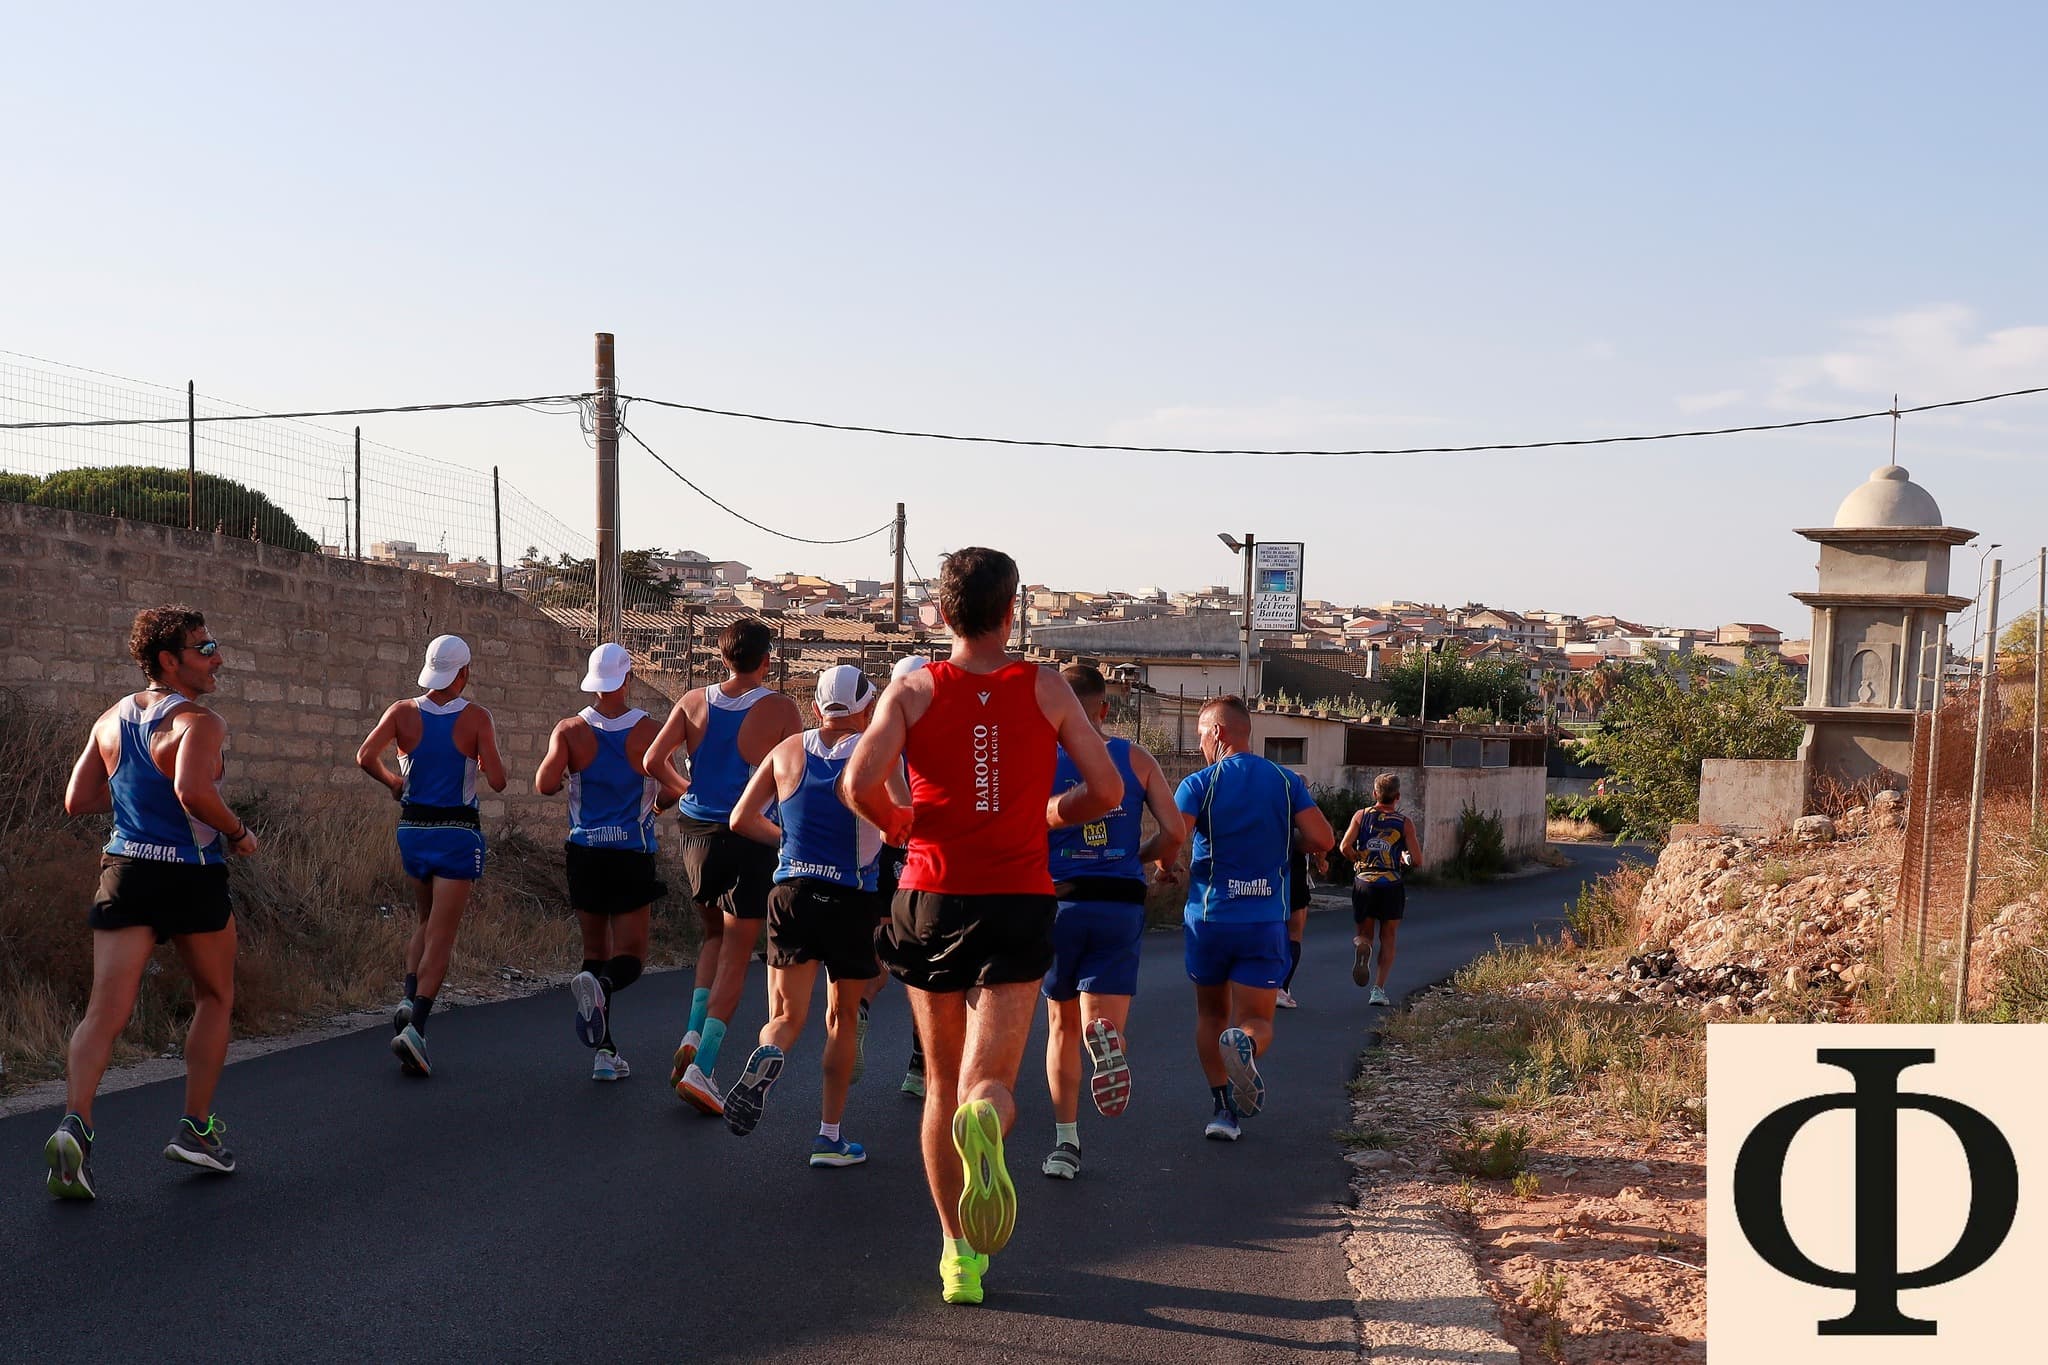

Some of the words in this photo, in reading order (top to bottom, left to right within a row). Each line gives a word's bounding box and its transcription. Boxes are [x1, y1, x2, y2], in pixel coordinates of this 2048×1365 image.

[1256, 601, 1271, 610] del
[1273, 601, 1296, 610] Ferro
[1263, 594, 1290, 602] L'Arte
[1259, 609, 1293, 618] Battuto
[991, 724, 999, 763] RAGUSA
[973, 724, 989, 812] BAROCCO
[992, 769, 1000, 812] RUNNING
